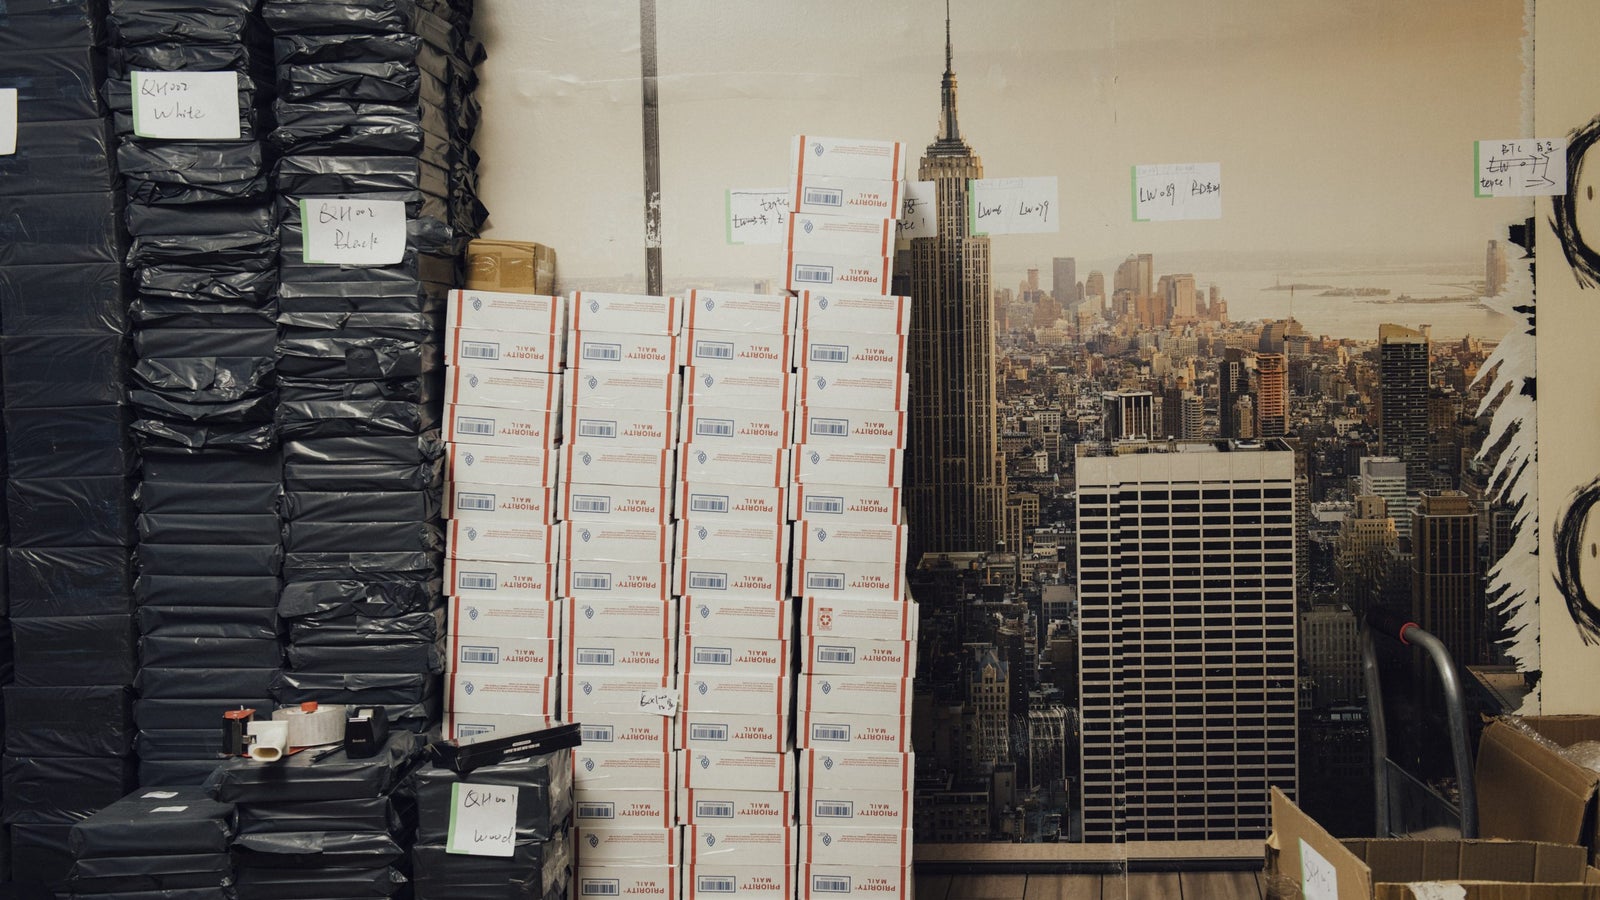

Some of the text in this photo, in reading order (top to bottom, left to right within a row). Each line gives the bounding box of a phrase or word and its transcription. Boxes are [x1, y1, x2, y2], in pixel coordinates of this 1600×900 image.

[153, 101, 206, 120] White
[849, 199, 887, 207] PRIORITY
[840, 276, 878, 284] PRIORITY
[506, 352, 544, 360] PRIORITY
[627, 353, 665, 361] PRIORITY
[740, 352, 778, 360] PRIORITY
[855, 355, 893, 363] PRIORITY
[501, 429, 539, 437] PRIORITY
[623, 430, 661, 438] PRIORITY
[740, 429, 778, 437] PRIORITY
[855, 429, 893, 437] PRIORITY
[502, 503, 540, 511] PRIORITY
[617, 506, 655, 514] PRIORITY
[735, 505, 773, 513] PRIORITY
[850, 505, 888, 513] PRIORITY
[503, 582, 541, 590] PRIORITY
[618, 582, 656, 590] PRIORITY
[734, 582, 772, 590] PRIORITY
[852, 582, 890, 590] PRIORITY
[505, 656, 543, 664] PRIORITY
[621, 657, 659, 665] PRIORITY
[738, 656, 776, 664] PRIORITY
[862, 655, 900, 663] PRIORITY
[620, 734, 658, 742] PRIORITY
[734, 733, 772, 741] PRIORITY
[857, 734, 895, 742] PRIORITY
[622, 810, 660, 818] PRIORITY
[740, 809, 778, 817] PRIORITY
[860, 810, 898, 818] PRIORITY
[626, 887, 664, 895] PRIORITY
[742, 883, 780, 891] PRIORITY
[858, 885, 896, 893] PRIORITY
